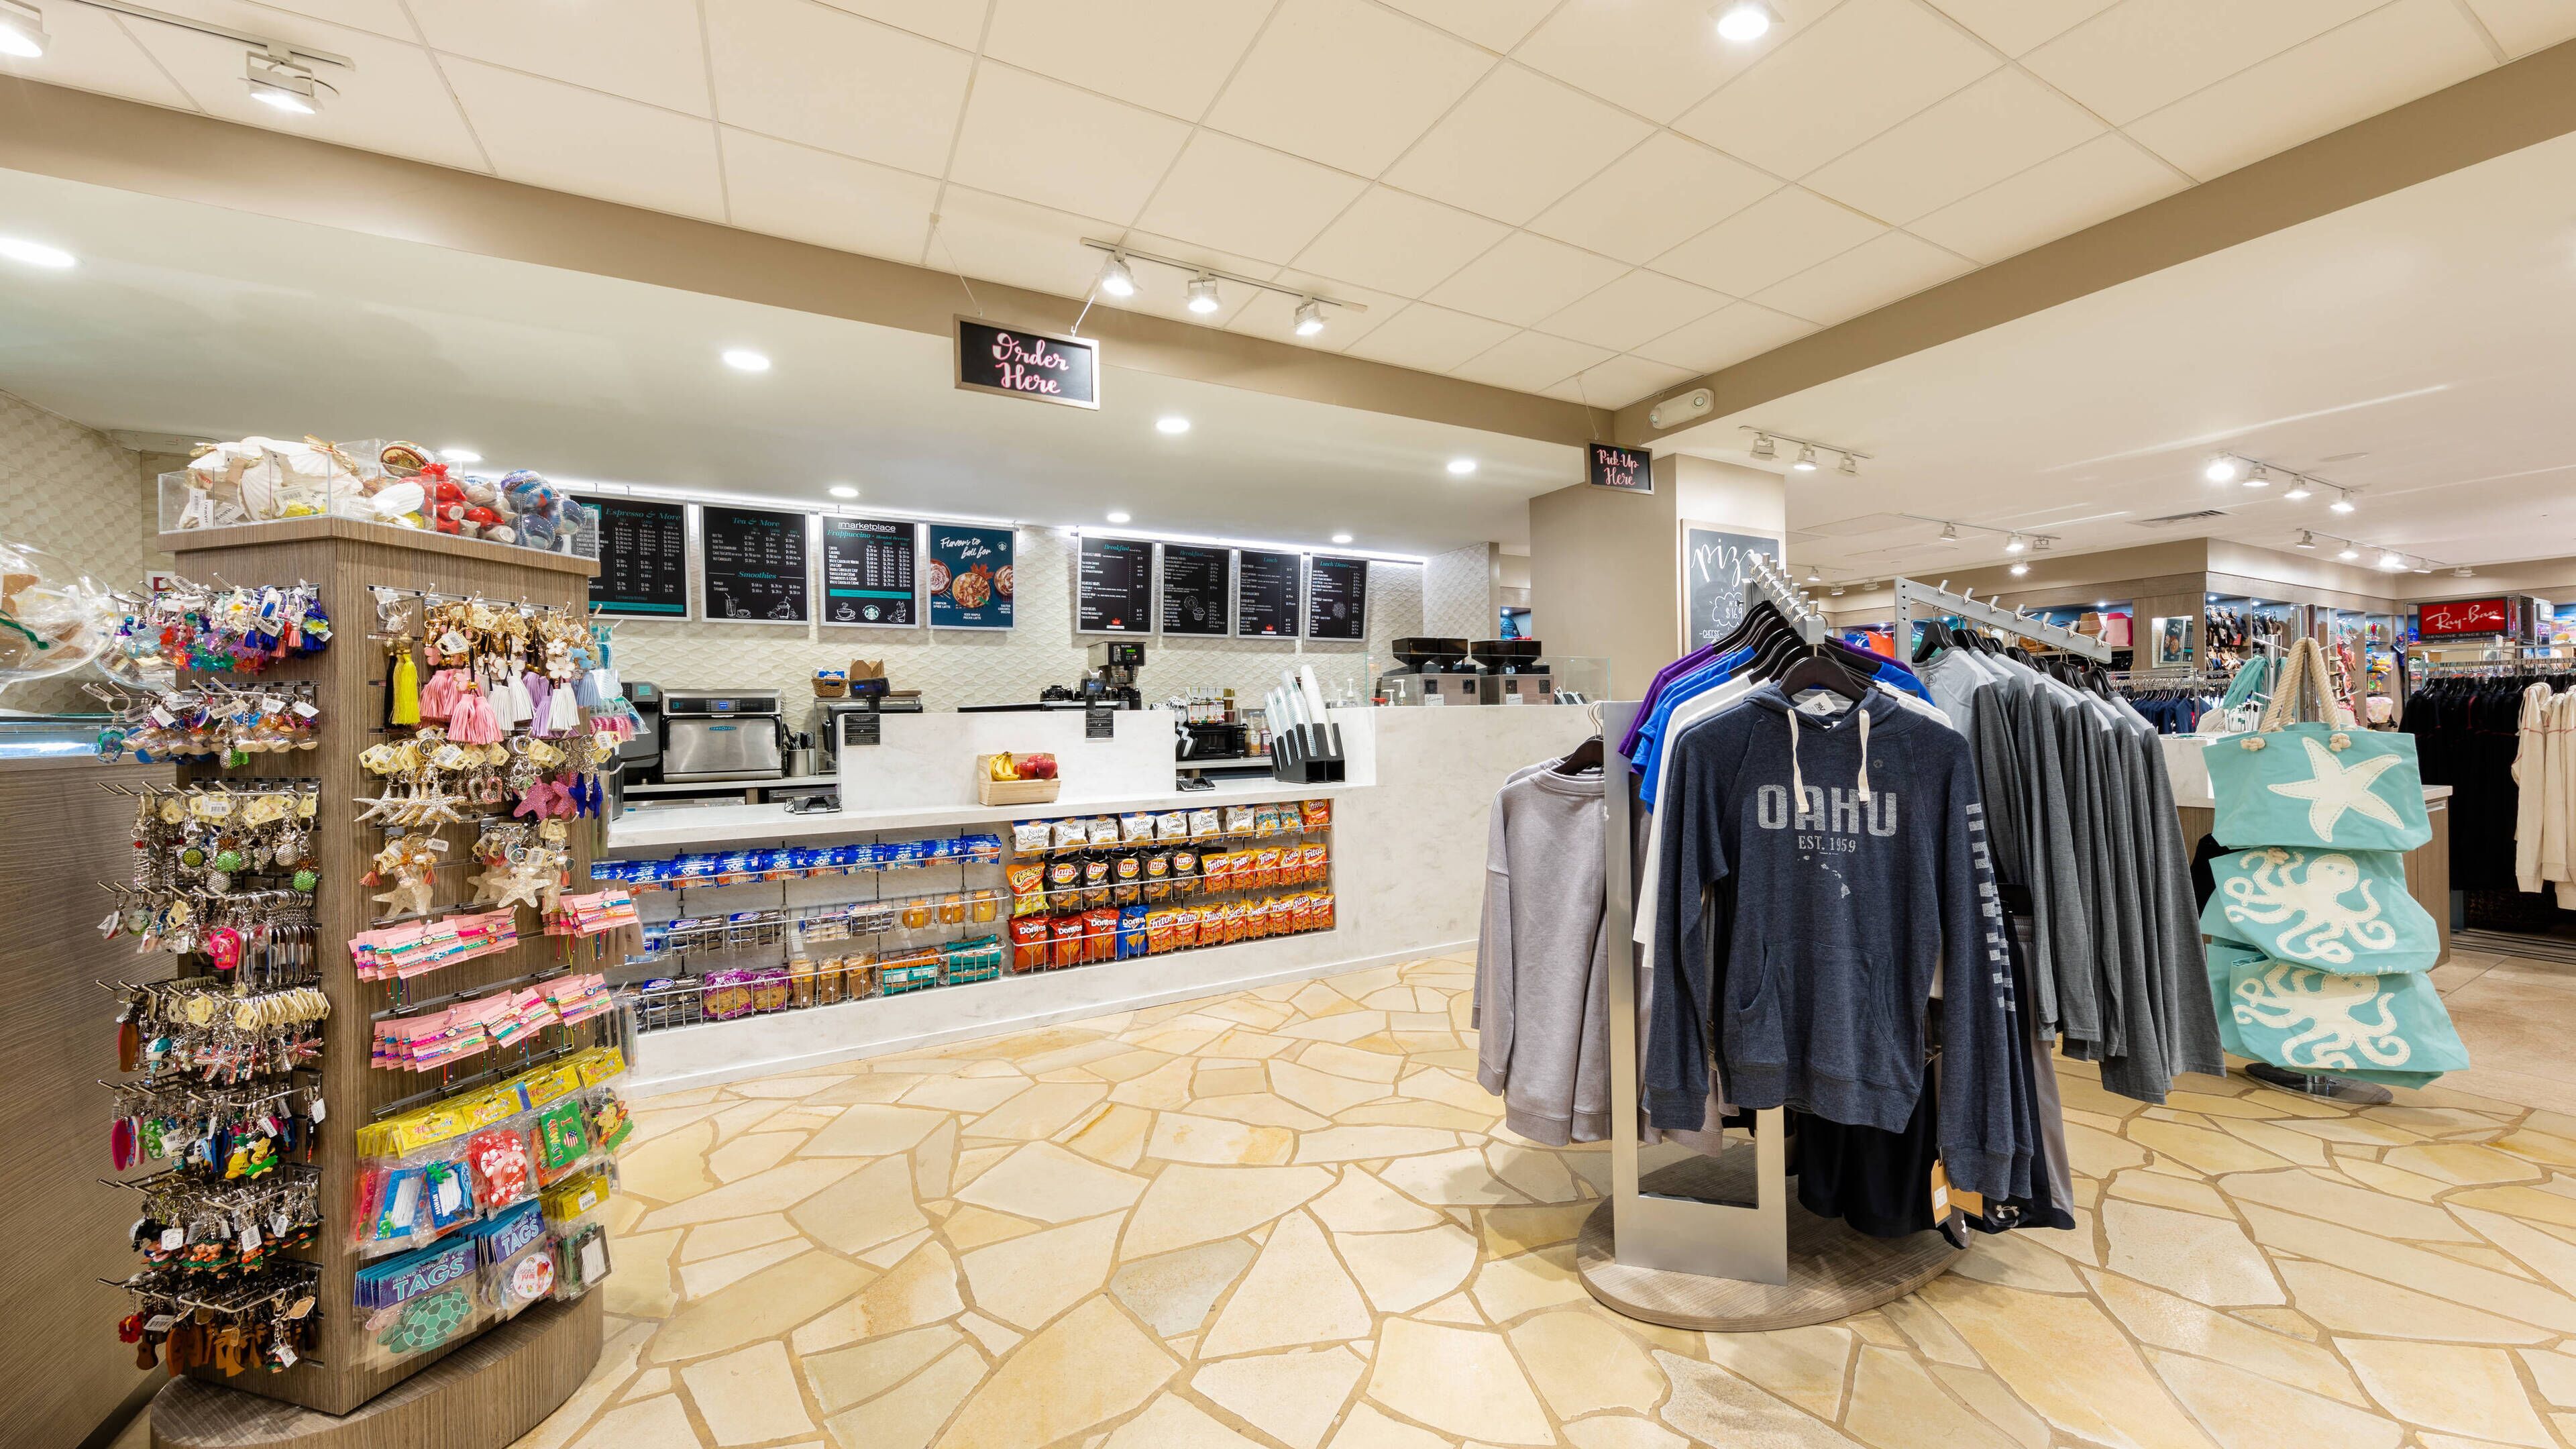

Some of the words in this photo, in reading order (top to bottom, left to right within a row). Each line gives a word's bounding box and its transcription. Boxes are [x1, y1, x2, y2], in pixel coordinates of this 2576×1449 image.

[992, 333, 1069, 370] Order
[995, 362, 1061, 393] Here
[1597, 448, 1639, 474] Pick-Up
[1604, 468, 1635, 486] Here
[606, 508, 644, 518] Espresso
[659, 513, 680, 521] More
[733, 517, 746, 525] Tea
[826, 529, 871, 539] Frappuccino
[841, 522, 896, 532] marketplace
[941, 537, 970, 549] Flavors
[961, 546, 977, 559] fall
[977, 546, 991, 558] for
[2426, 604, 2499, 630] Ray-Ban
[1758, 784, 1897, 837] OAHU
[1798, 835, 1825, 851] EST.
[1830, 837, 1857, 853] 1959
[1258, 851, 1277, 865] Fritos
[1304, 847, 1324, 859] Fritos
[1206, 858, 1228, 872] Fritos
[1012, 867, 1042, 886] Cheetos
[1293, 895, 1309, 909] ritos
[1091, 918, 1117, 927] Doritos
[1150, 914, 1173, 928] Fritos
[1176, 912, 1197, 924] Fritos
[1020, 924, 1046, 934] Doritos
[501, 1218, 539, 1256] TAGS
[392, 1257, 465, 1301] TAGS
